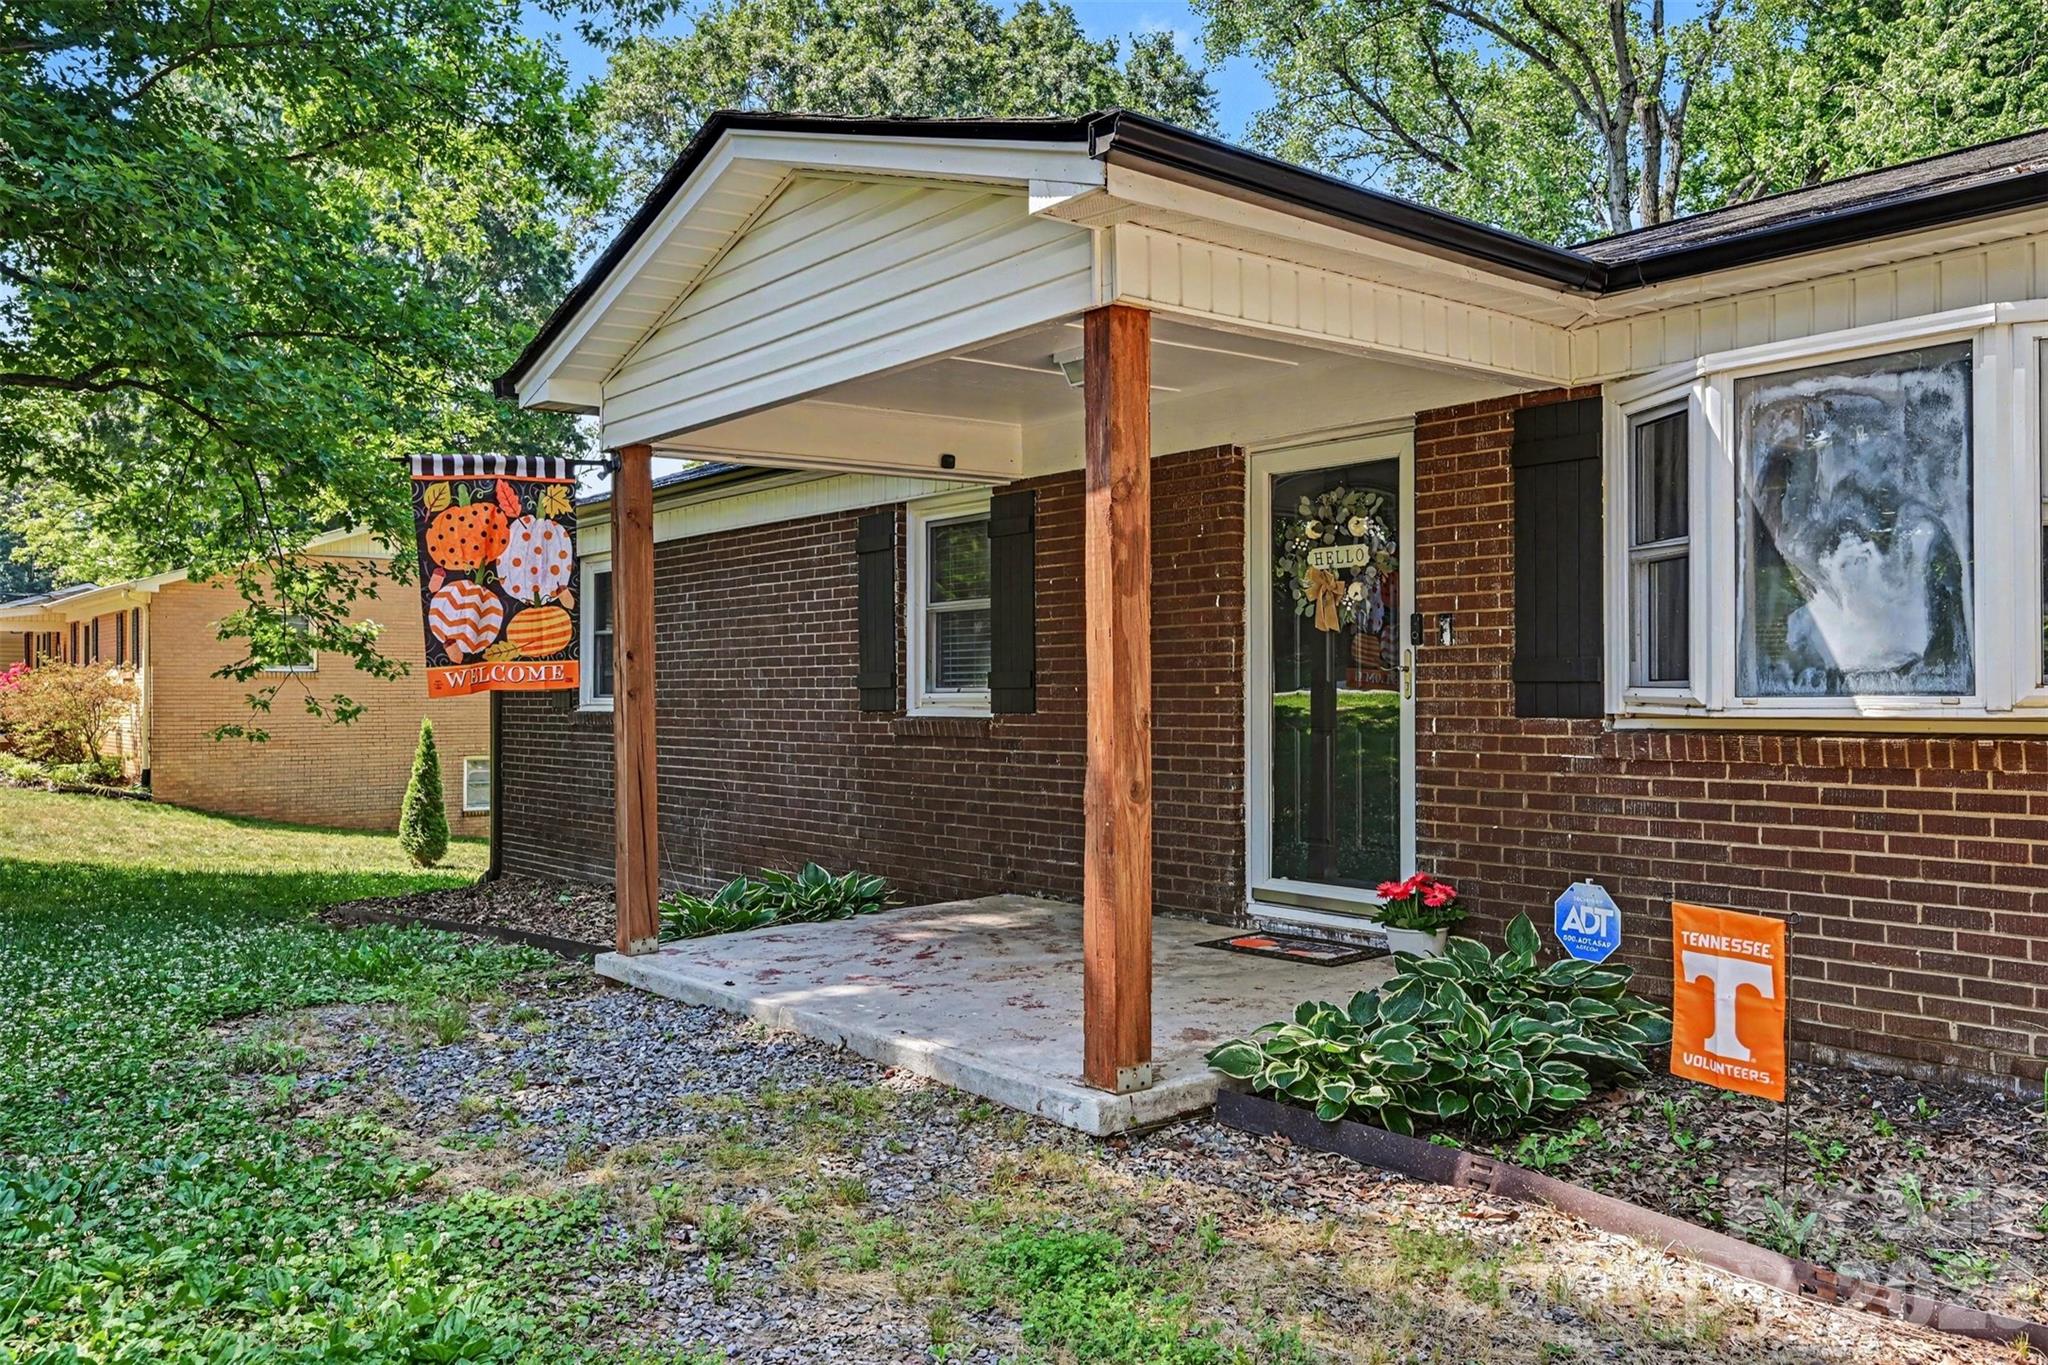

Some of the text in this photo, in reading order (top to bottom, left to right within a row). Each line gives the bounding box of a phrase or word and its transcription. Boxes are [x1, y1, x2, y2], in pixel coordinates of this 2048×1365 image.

[1314, 548, 1365, 565] HELLO
[444, 664, 565, 688] WELCOME
[1561, 905, 1614, 937] ADT
[1681, 931, 1772, 959] TENNESSEE
[1681, 949, 1775, 1063] T
[1683, 1052, 1771, 1085] VOLUNTEERS
